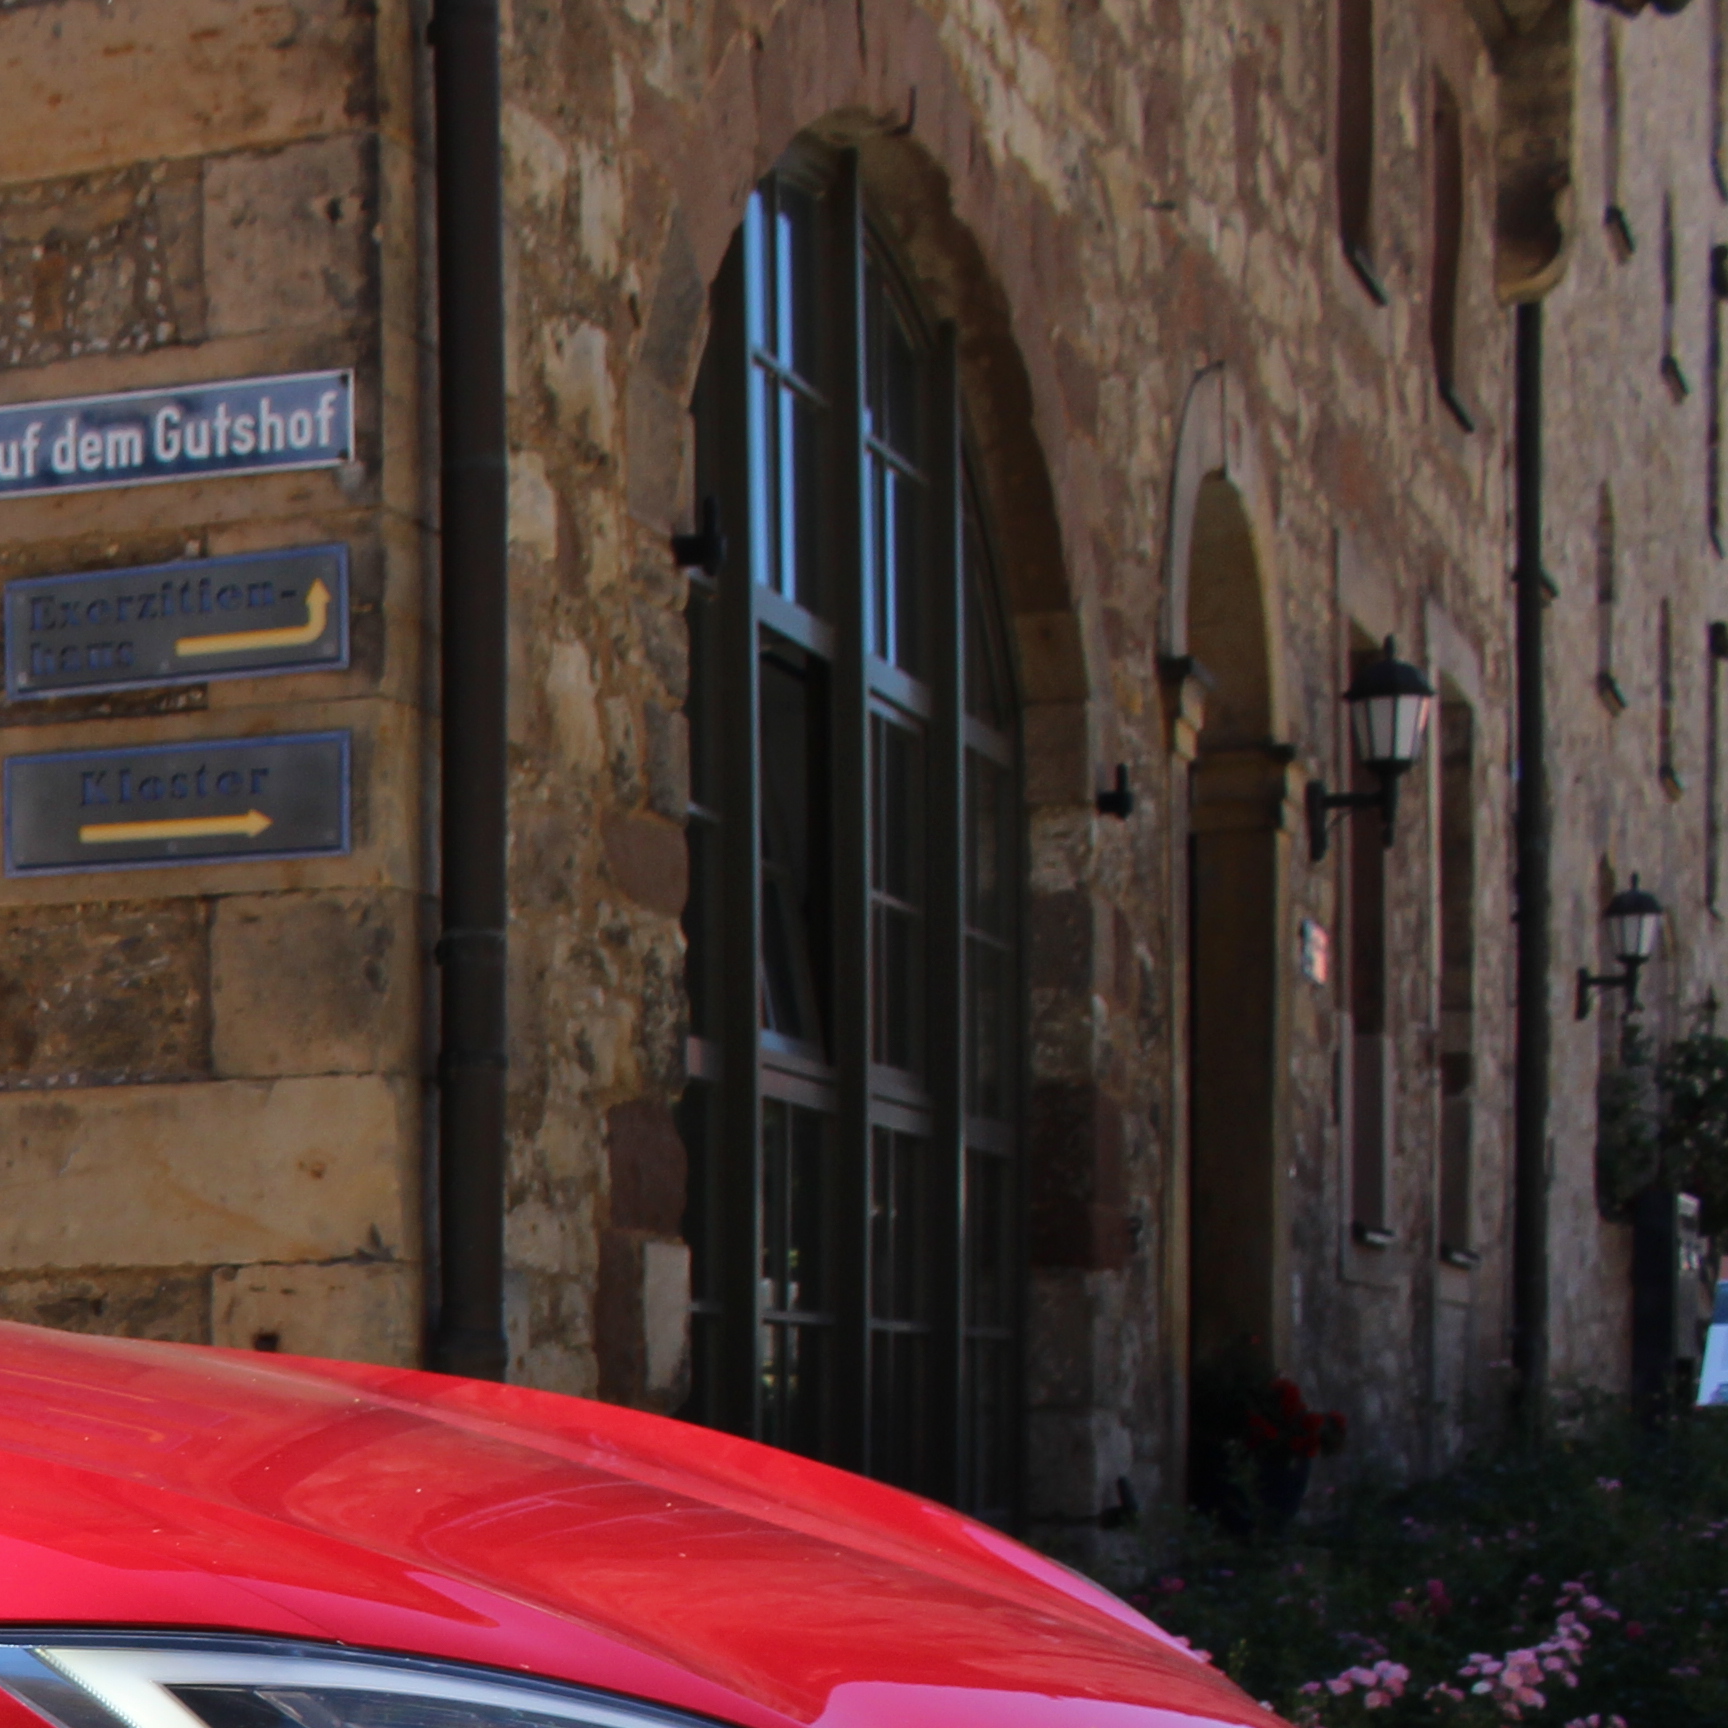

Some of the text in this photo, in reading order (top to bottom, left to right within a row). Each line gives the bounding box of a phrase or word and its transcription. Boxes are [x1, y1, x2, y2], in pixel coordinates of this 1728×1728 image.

[51, 417, 144, 471] dem
[153, 391, 338, 464] Gutshof
[79, 763, 270, 807] Kloster
